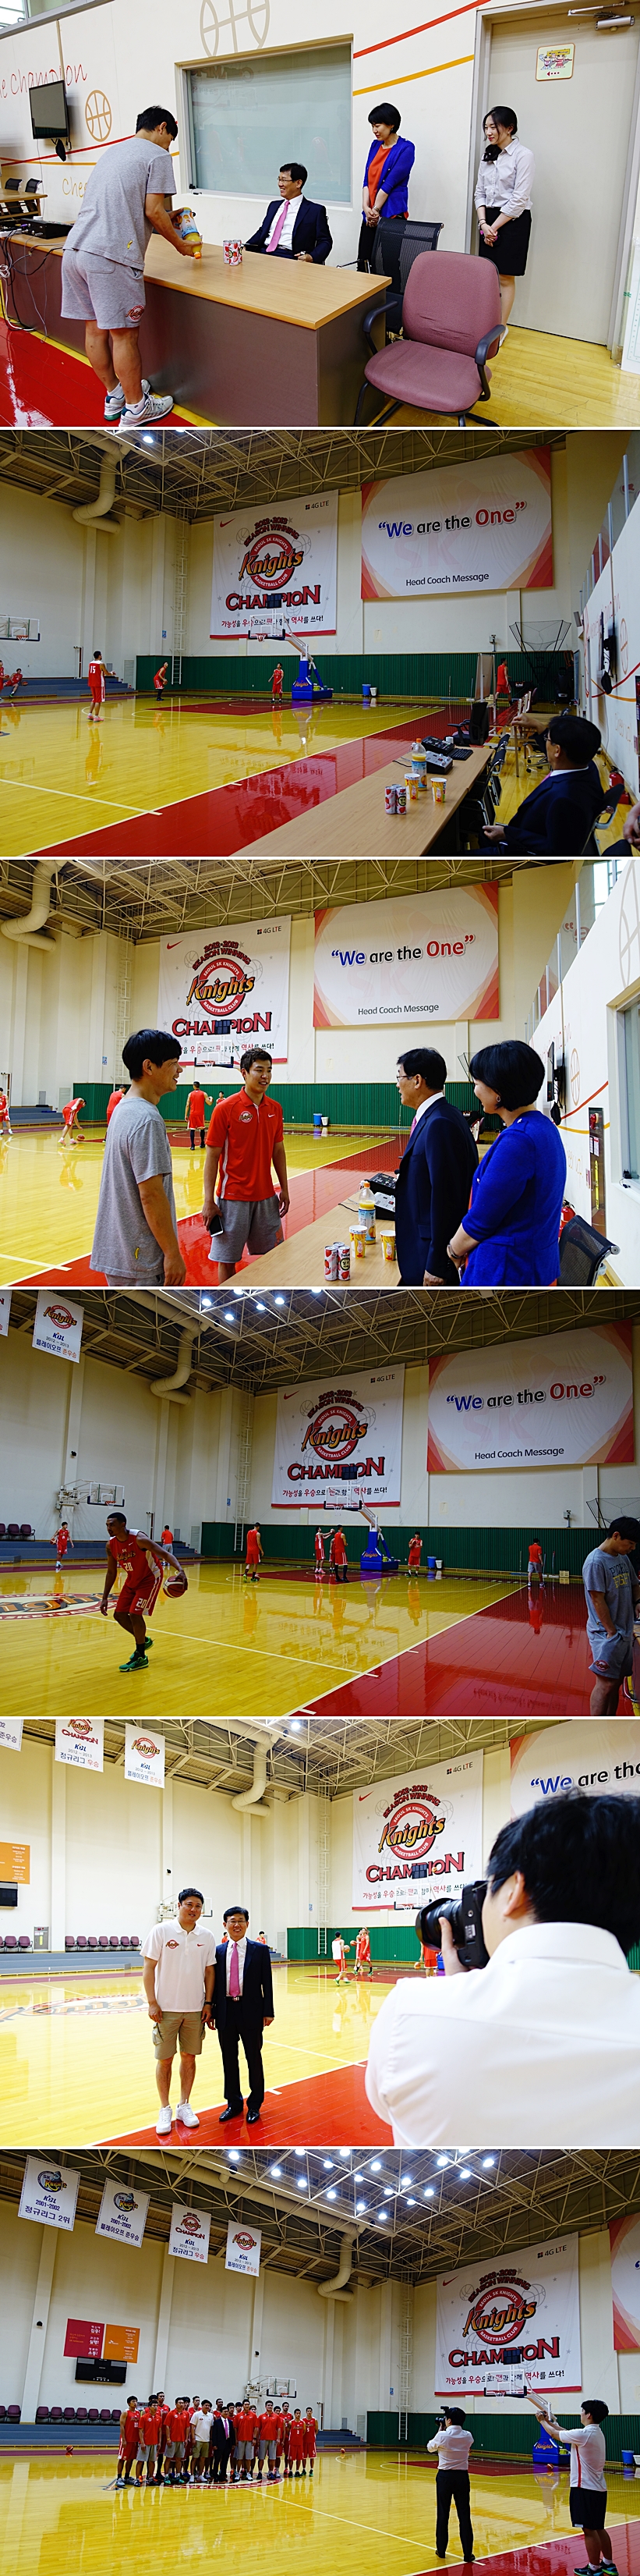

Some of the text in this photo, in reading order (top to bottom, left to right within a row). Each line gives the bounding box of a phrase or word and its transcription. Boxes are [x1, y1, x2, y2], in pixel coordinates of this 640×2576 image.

[417, 520, 440, 534] are
[444, 515, 471, 530] the
[243, 523, 299, 547] SEASON WINNING
[254, 539, 266, 552] SEOUL
[273, 538, 288, 549] KNIGHTS
[238, 548, 304, 581] Knights
[254, 573, 288, 587] BASKETBALL CLUB
[405, 573, 490, 586] Head Coach Message
[90, 665, 96, 674] 15
[192, 947, 252, 970] SEASON WINNING
[370, 950, 393, 963] are
[397, 946, 422, 960] the
[203, 963, 216, 977] SEOUL
[223, 961, 240, 975] KNIGHTS
[186, 974, 256, 1006] Knights
[203, 999, 239, 1013] BASKETBALL CLUB
[358, 1003, 440, 1016] Head Coach Message
[43, 1306, 78, 1326] Knights
[36, 1338, 76, 1359] 플레이오프 준우승
[486, 1394, 513, 1407] are
[517, 1389, 544, 1404] the
[307, 1396, 365, 1419] SEASON WINNING
[317, 1411, 330, 1424] SEOUL
[336, 1409, 353, 1422] KNIGHTS
[301, 1421, 368, 1452] Knights
[317, 1445, 352, 1458] BASKETBALL CLUB
[475, 1446, 564, 1460] Head Coach Message
[123, 1562, 133, 1571] 20
[136, 1598, 147, 1608] 20
[62, 1729, 98, 1744] CHAMPION
[131, 1740, 160, 1755] Knights
[60, 1752, 86, 1764] 정규리그
[462, 1762, 473, 1771] LTE
[578, 1770, 609, 1787] are
[383, 1792, 440, 1818] SEASON WINNING
[393, 1810, 405, 1823] SEOUL
[412, 1806, 429, 1818] KNIGHTS
[377, 1816, 446, 1853] Knights
[394, 1842, 429, 1857] BASKETBALL CLUB
[366, 1851, 465, 1882] CHAMION
[433, 1885, 451, 1893] 역사를
[35, 2199, 60, 2212] 2001-2002
[44, 2195, 57, 2204] KBL
[25, 2205, 71, 2224] 정규리그 2위
[117, 2214, 129, 2223] KBL
[110, 2218, 132, 2229] 2001-2002
[101, 2223, 140, 2241] 플레이오프 준우승
[175, 2227, 205, 2240] CHAMPION
[232, 2234, 257, 2247] Knights
[172, 2247, 193, 2257] 정규리그
[544, 2244, 567, 2257] 4G LTE
[468, 2276, 532, 2303] SEASON WINNING
[479, 2294, 492, 2307] SEOUL
[499, 2290, 518, 2302] KNIGHTS
[462, 2300, 537, 2337] Knights
[480, 2326, 518, 2342] BASKETBALL CLUB
[446, 2376, 467, 2385] 가능성을
